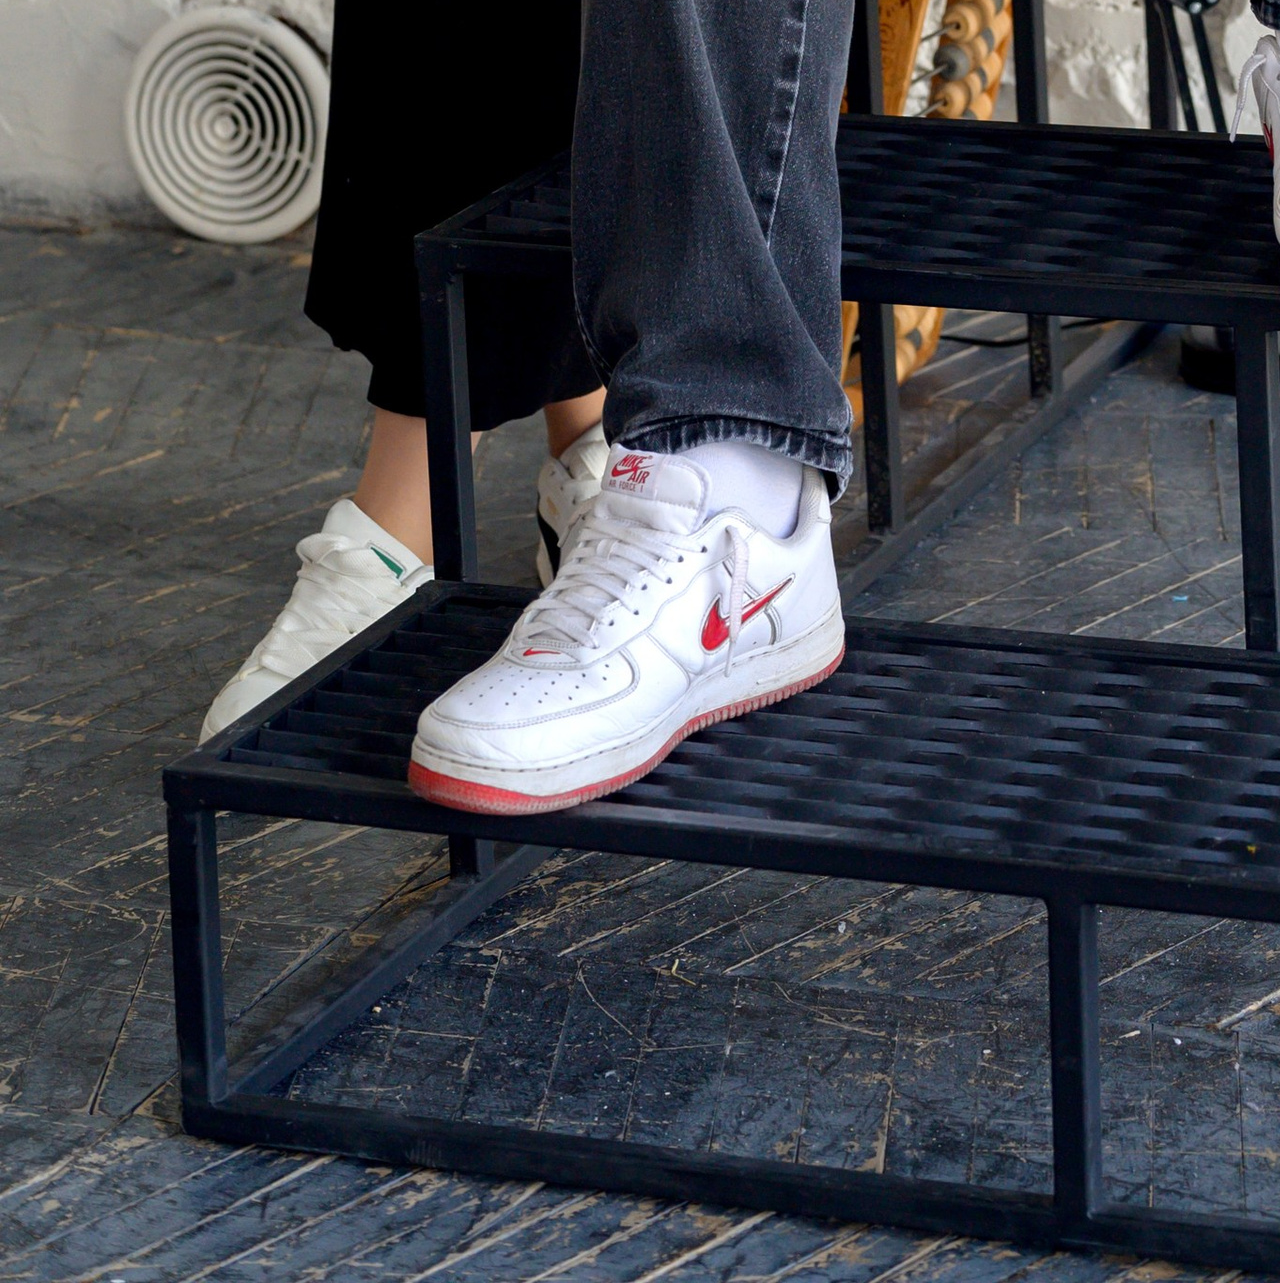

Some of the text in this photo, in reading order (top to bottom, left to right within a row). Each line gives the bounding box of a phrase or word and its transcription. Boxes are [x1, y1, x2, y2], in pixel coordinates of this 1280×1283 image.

[618, 454, 649, 468] NIKE
[627, 471, 650, 484] AIR
[608, 480, 617, 488] AIR
[618, 480, 636, 492] FORCE
